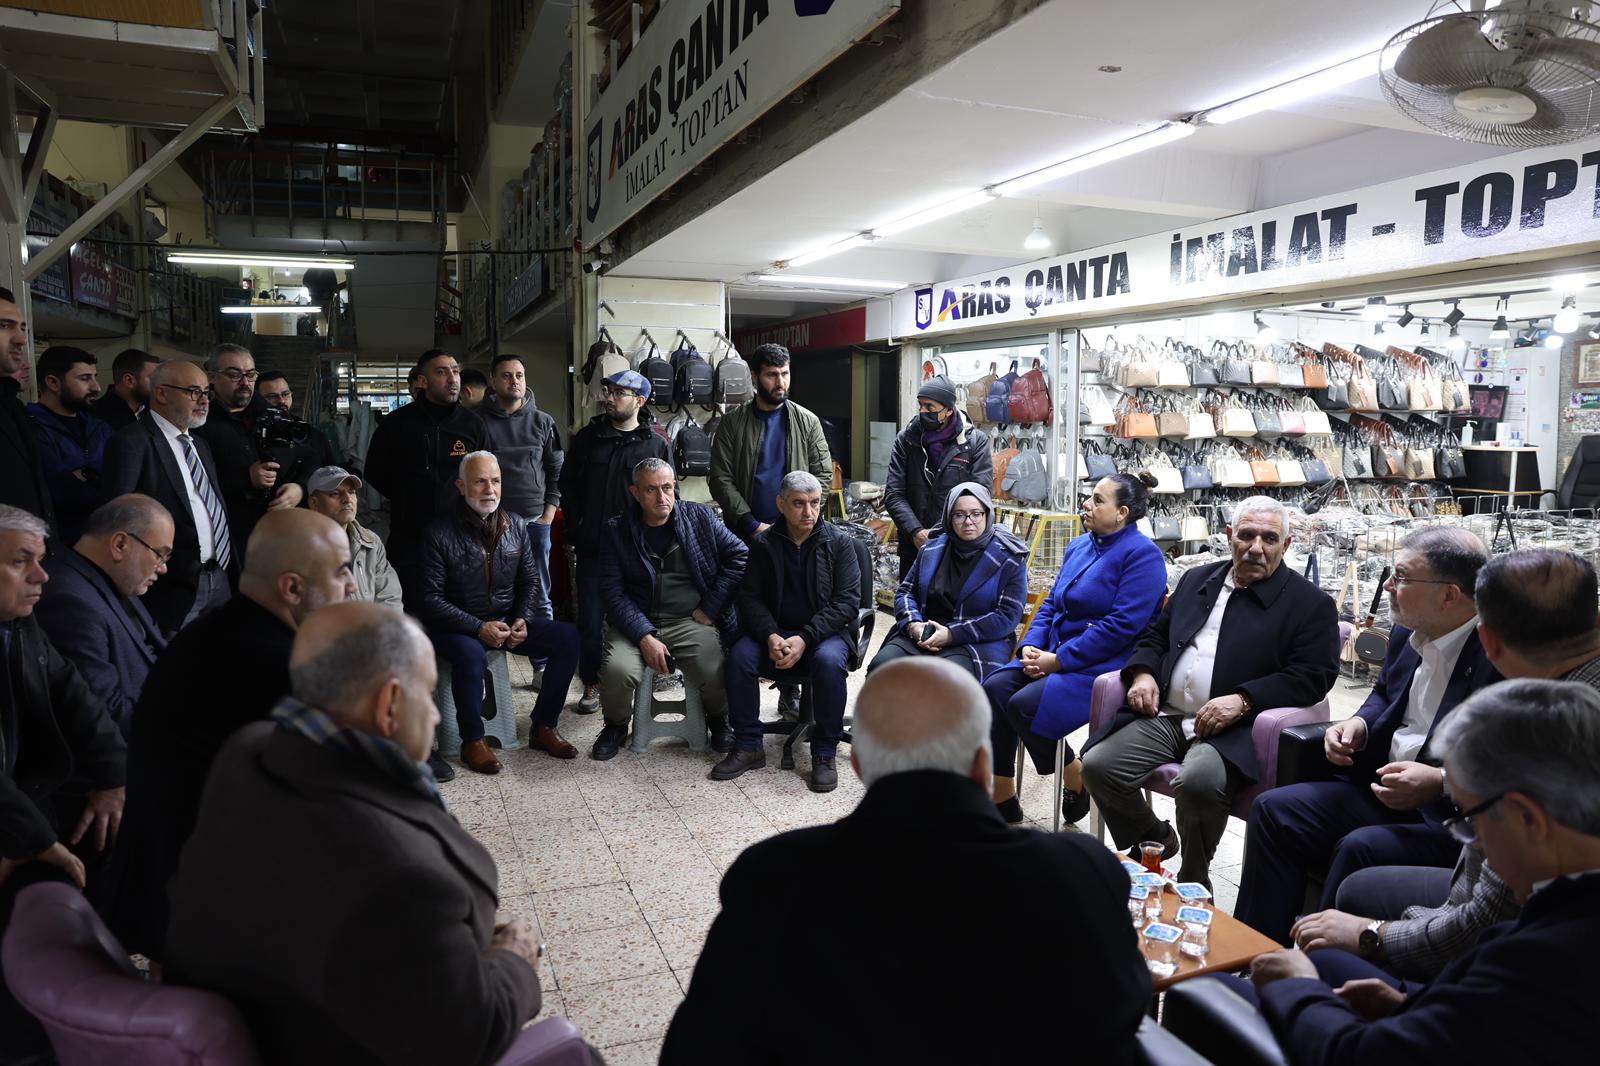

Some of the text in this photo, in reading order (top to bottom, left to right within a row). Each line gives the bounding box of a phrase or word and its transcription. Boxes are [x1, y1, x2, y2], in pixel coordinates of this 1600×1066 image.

[608, 65, 661, 181] ARAS
[625, 138, 668, 203] İMALAT
[679, 59, 749, 156] TOPTAN
[937, 276, 1011, 322] ARAS
[1024, 251, 1131, 316] ÇANTA
[1169, 203, 1358, 286] İMALAT
